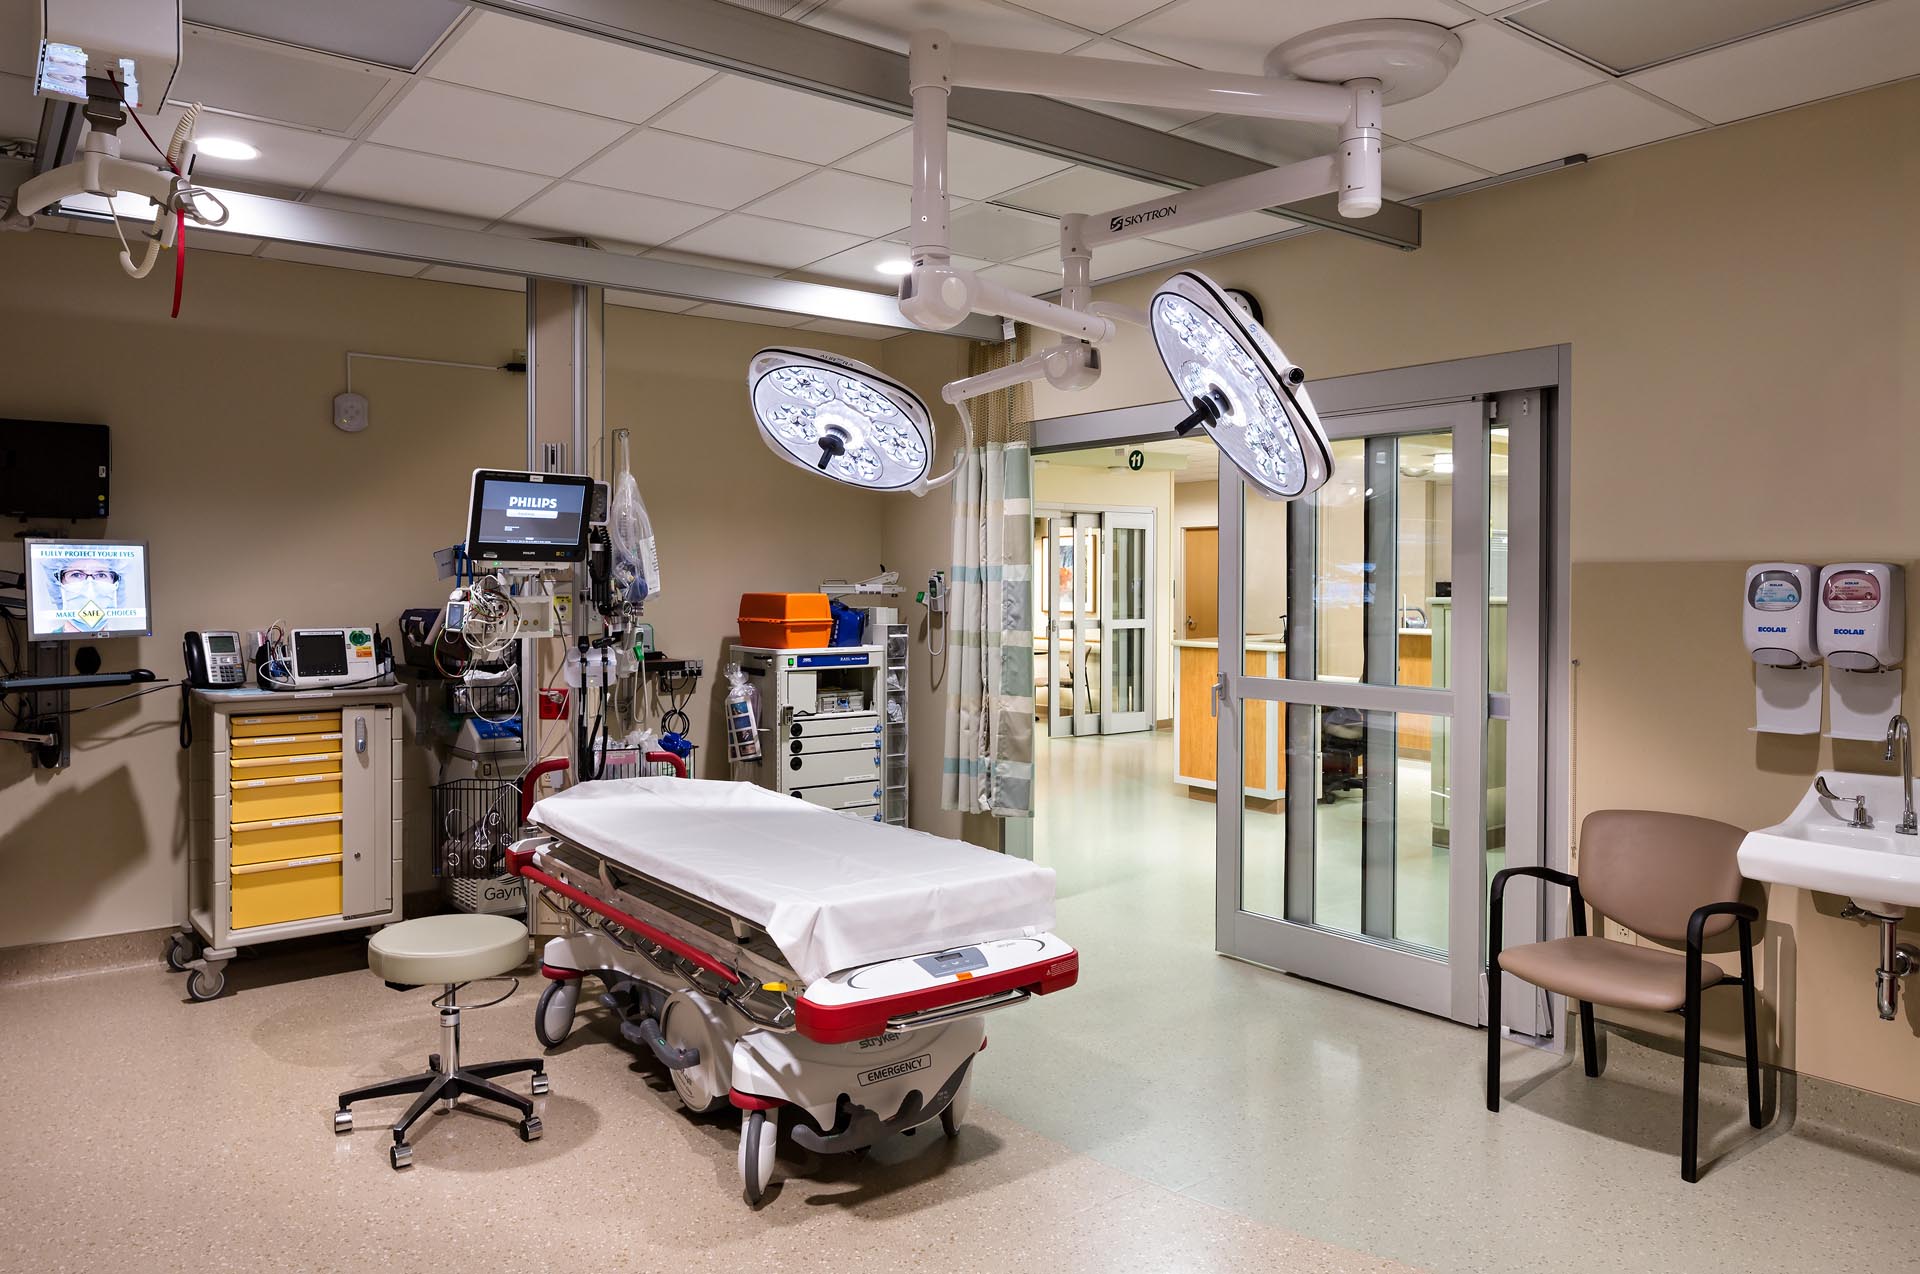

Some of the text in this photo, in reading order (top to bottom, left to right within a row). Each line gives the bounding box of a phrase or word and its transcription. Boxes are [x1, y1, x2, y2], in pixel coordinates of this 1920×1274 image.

[1124, 205, 1177, 227] SKYTRON
[1131, 454, 1141, 467] 11
[509, 496, 558, 509] PHILIPS
[106, 609, 137, 617] CHOICES
[859, 1032, 901, 1049] stryker
[868, 1058, 922, 1081] EMERGENCY
